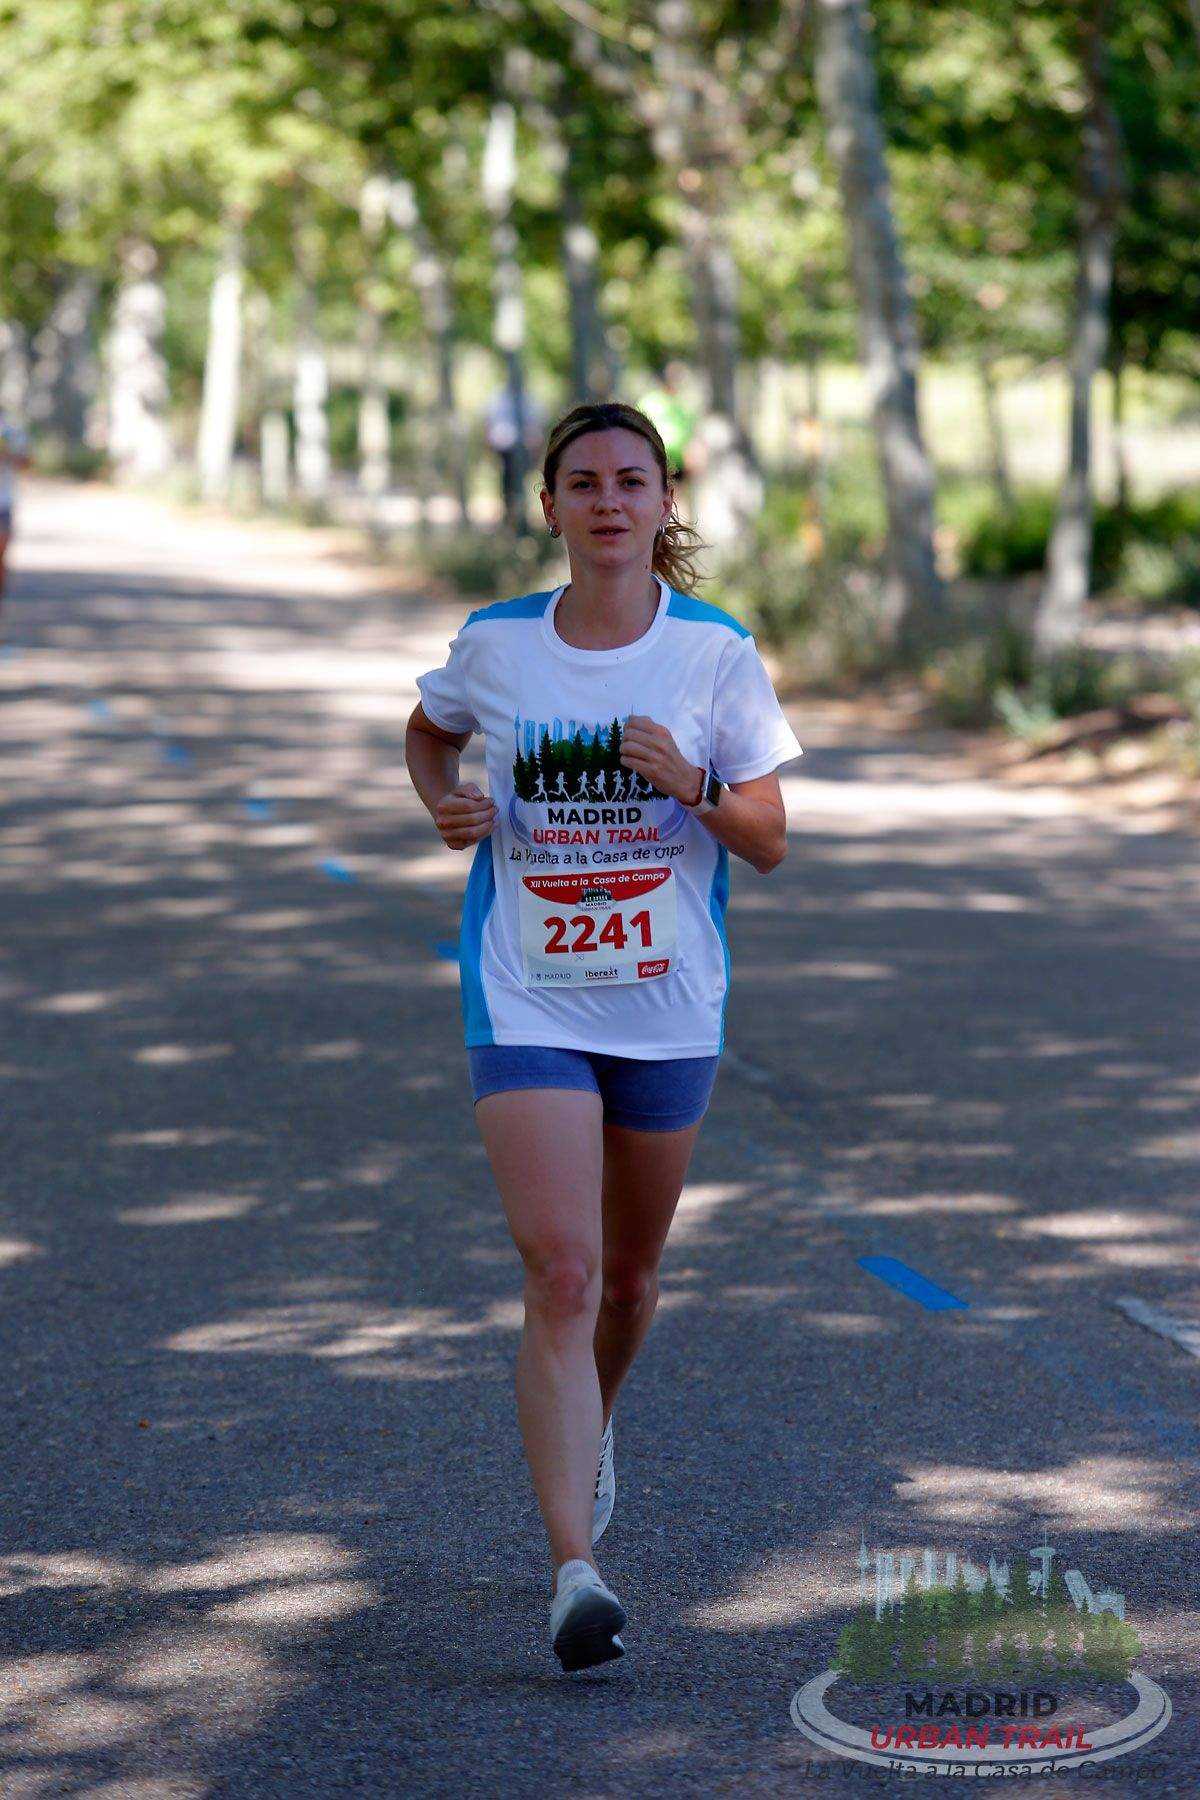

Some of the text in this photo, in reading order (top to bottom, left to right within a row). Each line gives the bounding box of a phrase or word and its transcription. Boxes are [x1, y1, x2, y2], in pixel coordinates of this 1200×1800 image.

[547, 807, 642, 825] MADRID
[533, 827, 660, 845] URBAN TRAIL
[509, 847, 522, 861] La
[563, 854, 572, 864] a
[576, 852, 588, 864] la
[592, 850, 628, 864] Casa
[632, 848, 650, 859] de
[530, 880, 541, 888] XII
[542, 878, 570, 887] Vuelta
[579, 878, 589, 886] la
[593, 876, 616, 885] Casa
[618, 874, 630, 883] de
[631, 872, 665, 882] Campo
[543, 910, 652, 954] 2241
